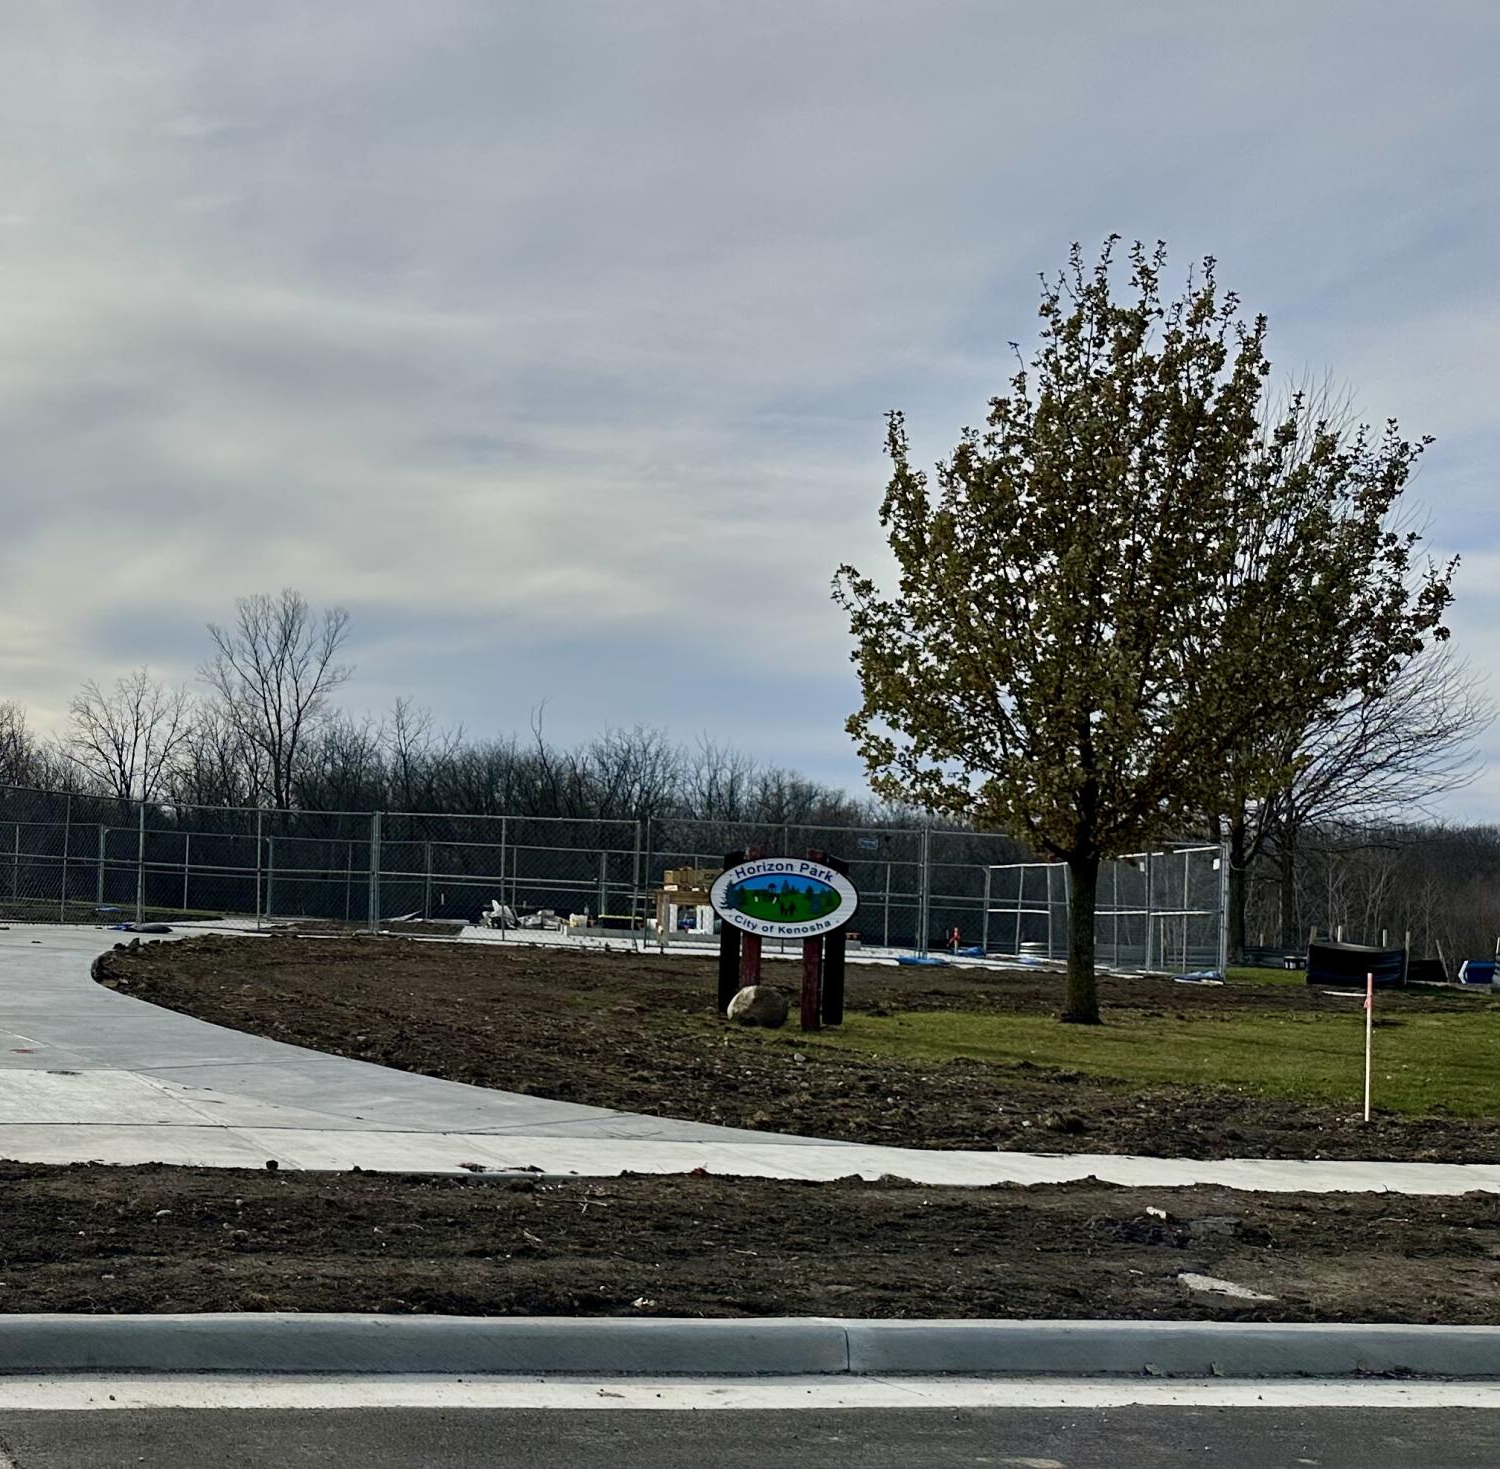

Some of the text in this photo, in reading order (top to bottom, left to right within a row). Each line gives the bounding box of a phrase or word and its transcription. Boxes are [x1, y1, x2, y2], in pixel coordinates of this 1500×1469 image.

[735, 862, 834, 882] Horizon Park
[734, 915, 831, 934] City of Kenosha
